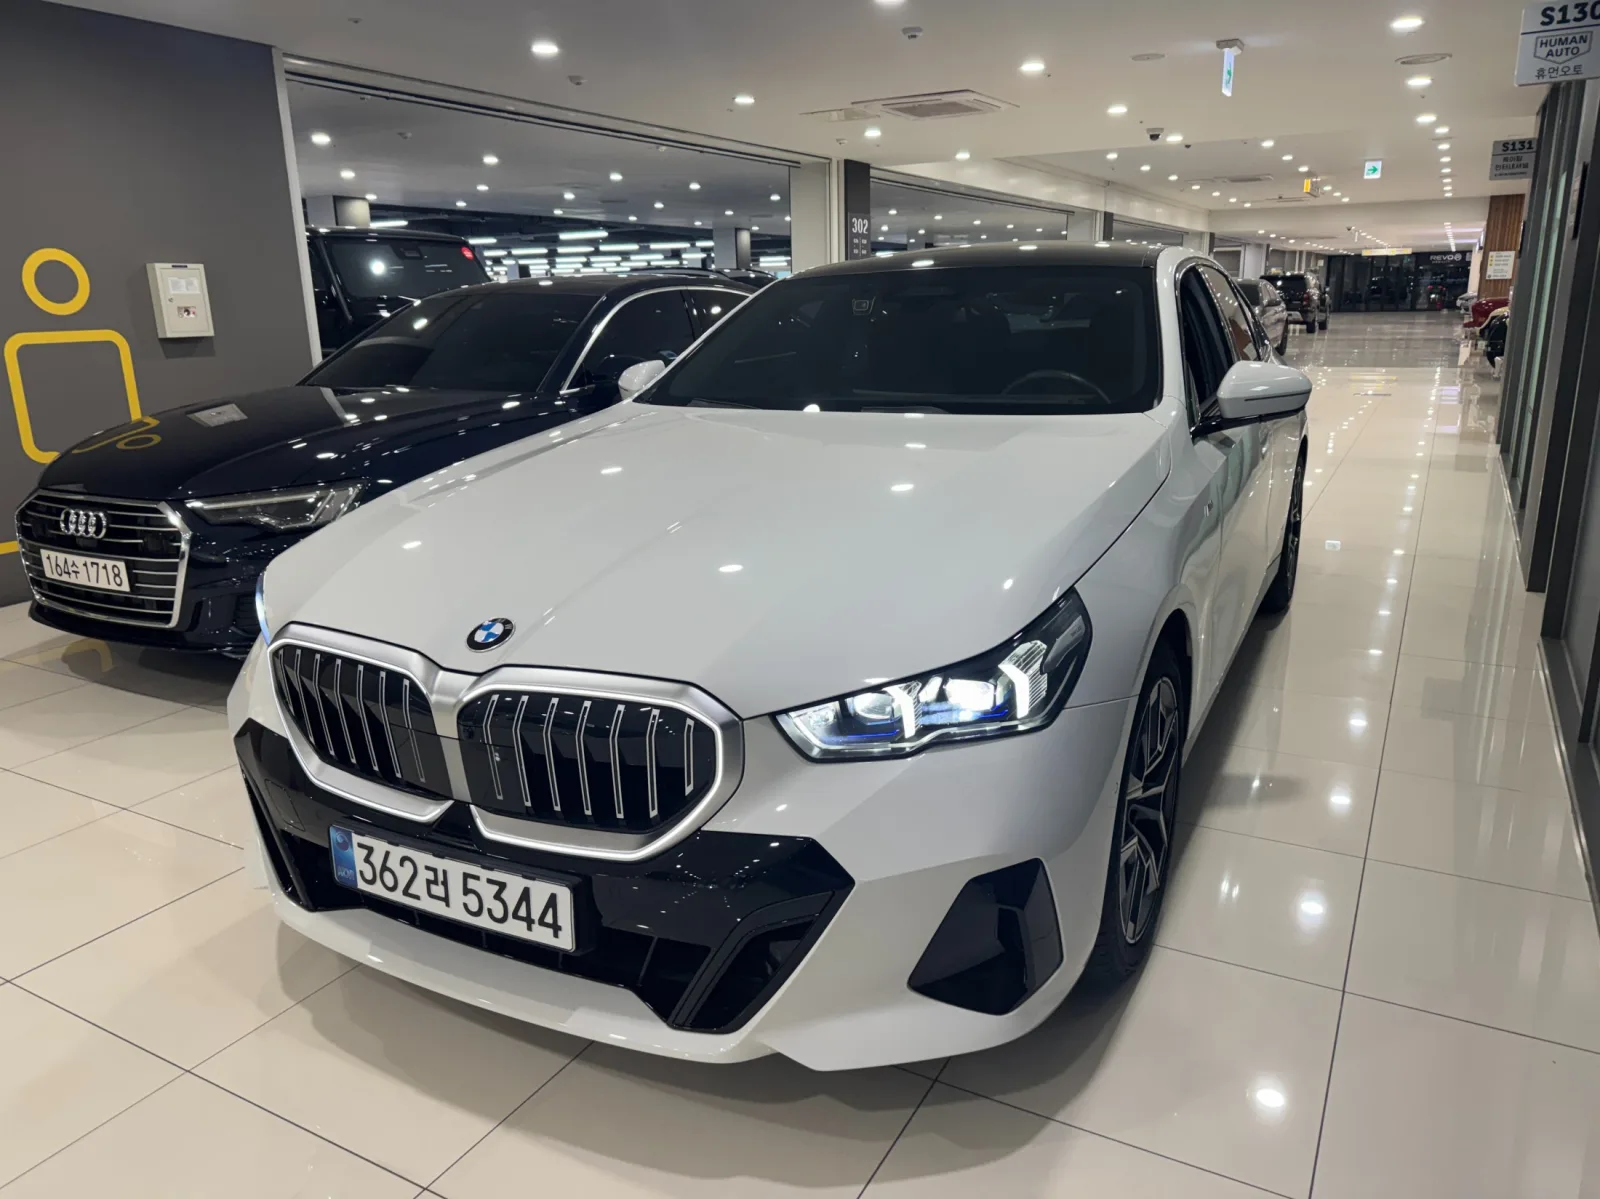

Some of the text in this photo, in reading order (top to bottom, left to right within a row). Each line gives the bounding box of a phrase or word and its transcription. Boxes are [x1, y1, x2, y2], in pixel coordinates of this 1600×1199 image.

[1539, 34, 1588, 48] HUMAN
[1545, 46, 1580, 58] AUTO
[1535, 64, 1584, 80] 휴먼오토
[1502, 140, 1534, 152] S131
[852, 217, 869, 234] 302
[357, 842, 562, 939] 362러 5344
